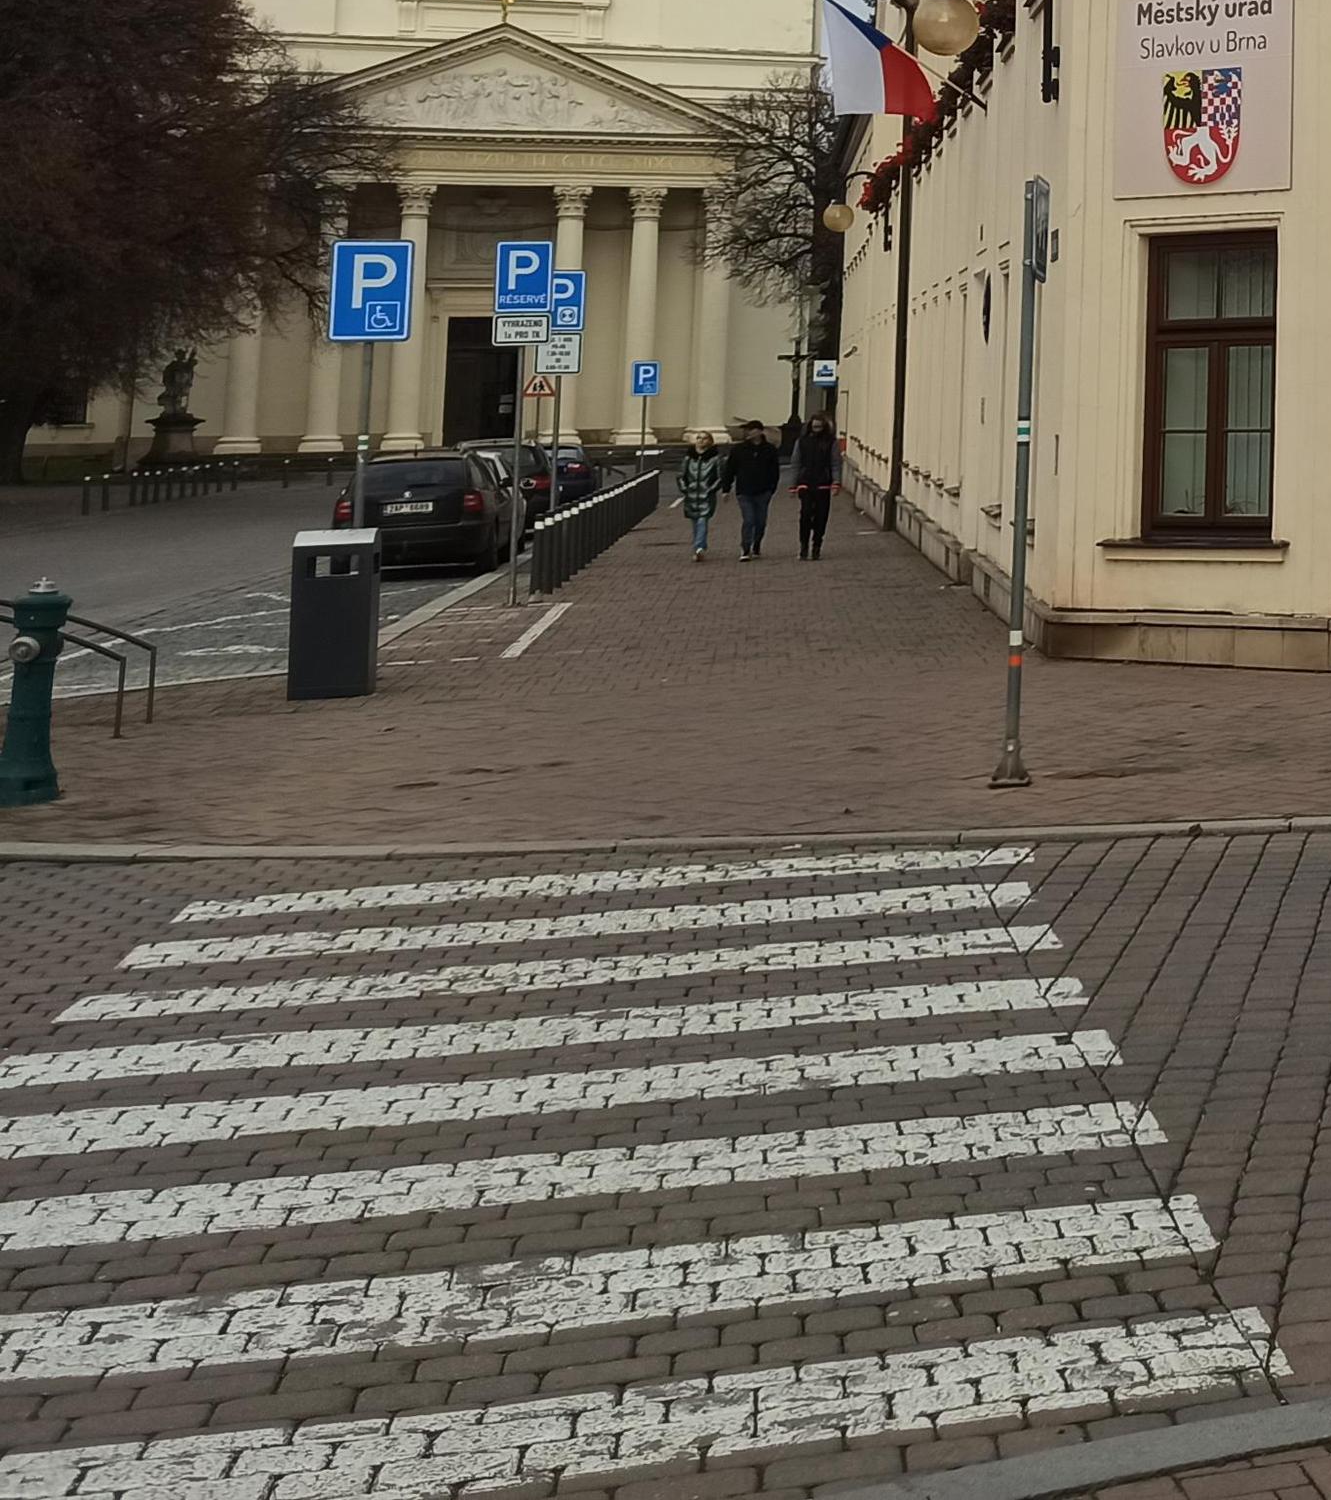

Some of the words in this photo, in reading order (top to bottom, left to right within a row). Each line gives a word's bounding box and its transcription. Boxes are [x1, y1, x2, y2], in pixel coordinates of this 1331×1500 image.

[1140, 35, 1204, 59] Slavkov
[1210, 40, 1220, 53] u
[1226, 31, 1267, 52] Brna
[351, 254, 398, 309] P
[507, 250, 540, 290] P
[499, 293, 546, 304] RÉSERVÉ
[552, 278, 575, 311] P
[638, 365, 654, 385] P
